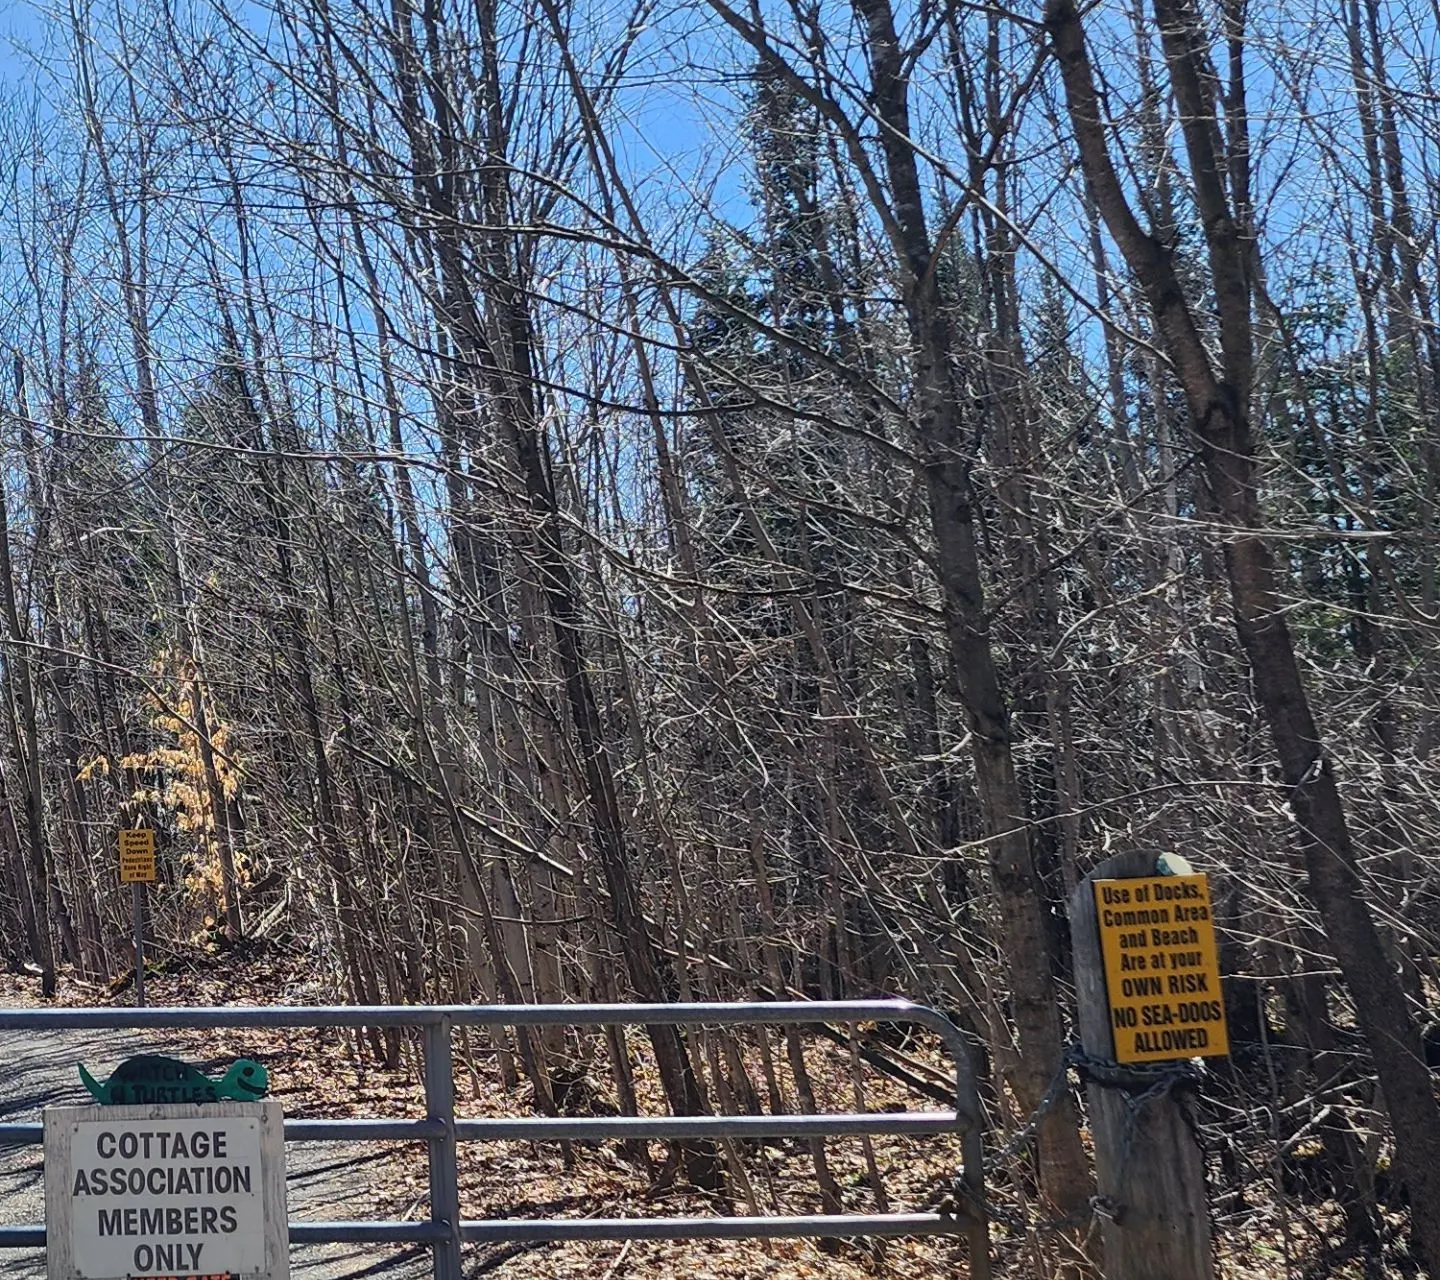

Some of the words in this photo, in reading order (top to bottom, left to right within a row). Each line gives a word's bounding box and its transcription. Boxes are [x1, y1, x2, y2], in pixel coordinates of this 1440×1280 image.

[124, 839, 149, 847] Speed
[1101, 886, 1130, 904] Use
[1135, 884, 1149, 902] of
[1153, 881, 1204, 902] Docks,
[1103, 908, 1169, 927] Common
[1174, 905, 1208, 922] Area
[1119, 929, 1147, 948] and
[1152, 926, 1199, 946] Beach
[1120, 953, 1146, 971] Are
[1150, 952, 1167, 969] at
[1171, 951, 1203, 970] your
[1121, 976, 1163, 997] OWN
[1167, 973, 1208, 994] RISK
[1113, 1006, 1137, 1028] NO
[1134, 1028, 1208, 1053] ALLOWED
[131, 1085, 217, 1103] TURTLES
[96, 1131, 227, 1159] COTTAGE
[73, 1166, 251, 1196] ASSOCIATION
[98, 1206, 237, 1236] MEMBERS
[133, 1243, 204, 1272] ONLY
